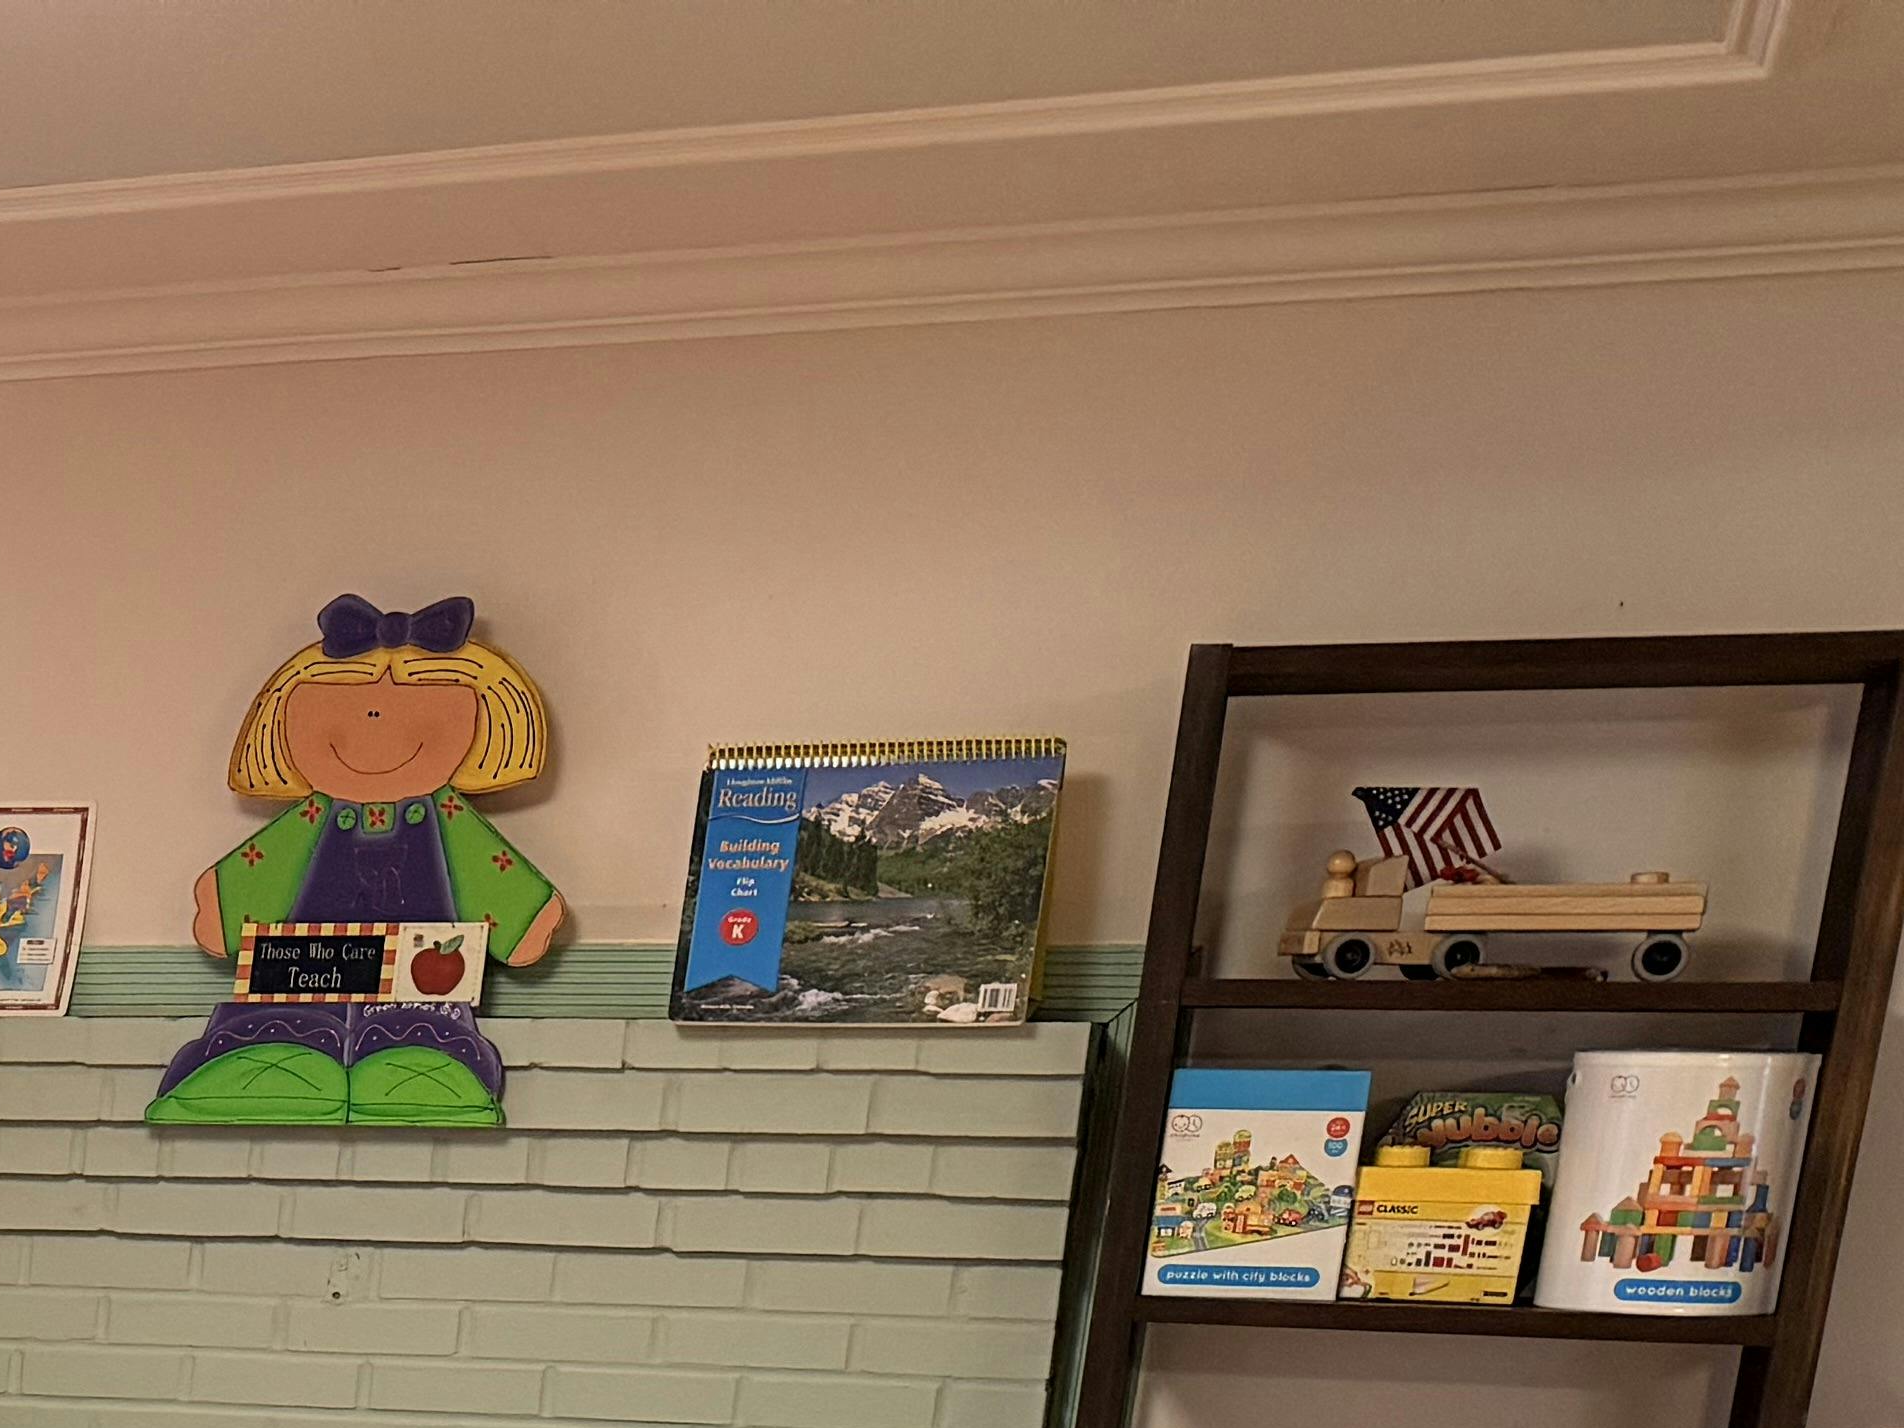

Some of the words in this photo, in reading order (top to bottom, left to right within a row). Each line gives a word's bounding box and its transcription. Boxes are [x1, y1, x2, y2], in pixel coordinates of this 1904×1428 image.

[718, 787, 796, 811] Reading
[720, 838, 780, 855] Building
[708, 856, 789, 872] Vocabulary
[260, 942, 300, 960] Those
[309, 942, 334, 960] Who
[342, 943, 376, 960] Care
[288, 966, 342, 989] Teach
[1376, 1204, 1418, 1215] CLASSIC
[1165, 1270, 1208, 1282] puzzle
[1212, 1270, 1239, 1281] with
[1242, 1272, 1265, 1283] city
[1269, 1271, 1311, 1283] blocks
[1626, 1285, 1684, 1298] wooden
[1689, 1284, 1733, 1299] blocks
